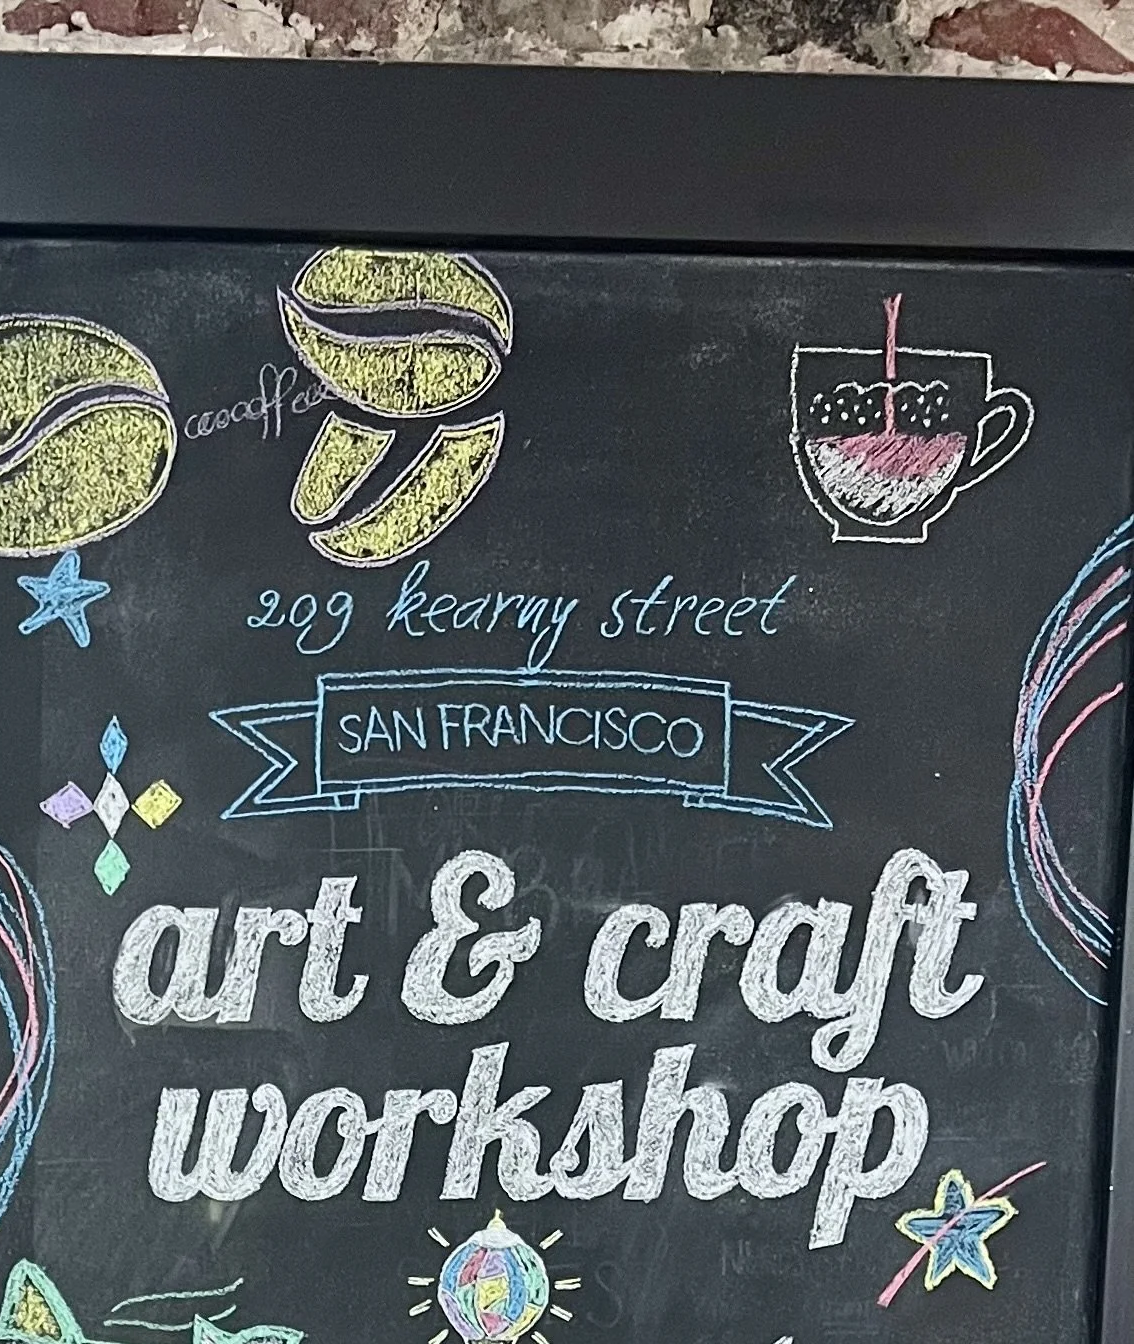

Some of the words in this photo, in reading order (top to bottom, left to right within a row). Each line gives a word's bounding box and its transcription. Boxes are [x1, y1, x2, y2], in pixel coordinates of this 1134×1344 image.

[247, 589, 354, 655] 209
[387, 560, 581, 673] kearny
[600, 574, 798, 638] street
[339, 705, 426, 753] SAN
[442, 703, 704, 758] FRANCISCO
[113, 875, 368, 1025] art
[401, 850, 542, 1025] &
[584, 847, 985, 1072] craft
[147, 1041, 930, 1250] workshop
